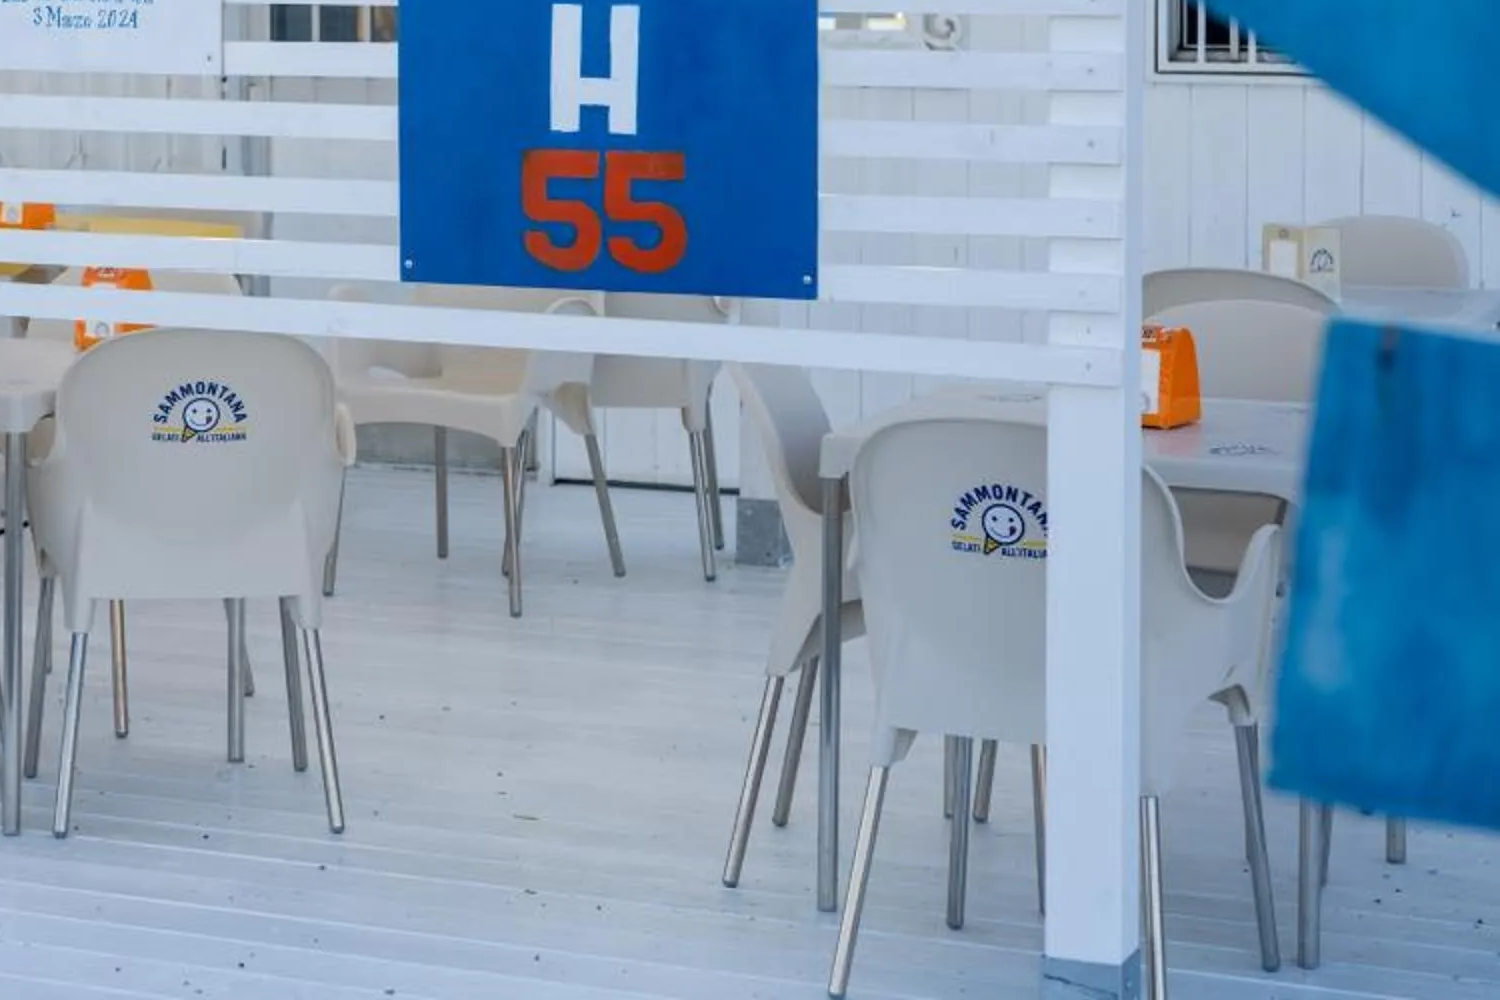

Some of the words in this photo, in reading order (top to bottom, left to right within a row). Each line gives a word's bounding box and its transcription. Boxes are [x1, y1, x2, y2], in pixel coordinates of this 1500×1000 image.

[97, 8, 138, 29] 2024
[521, 148, 688, 275] 55
[153, 381, 248, 424] SAMMONTANA
[951, 483, 1048, 537] SAMMONTAN
